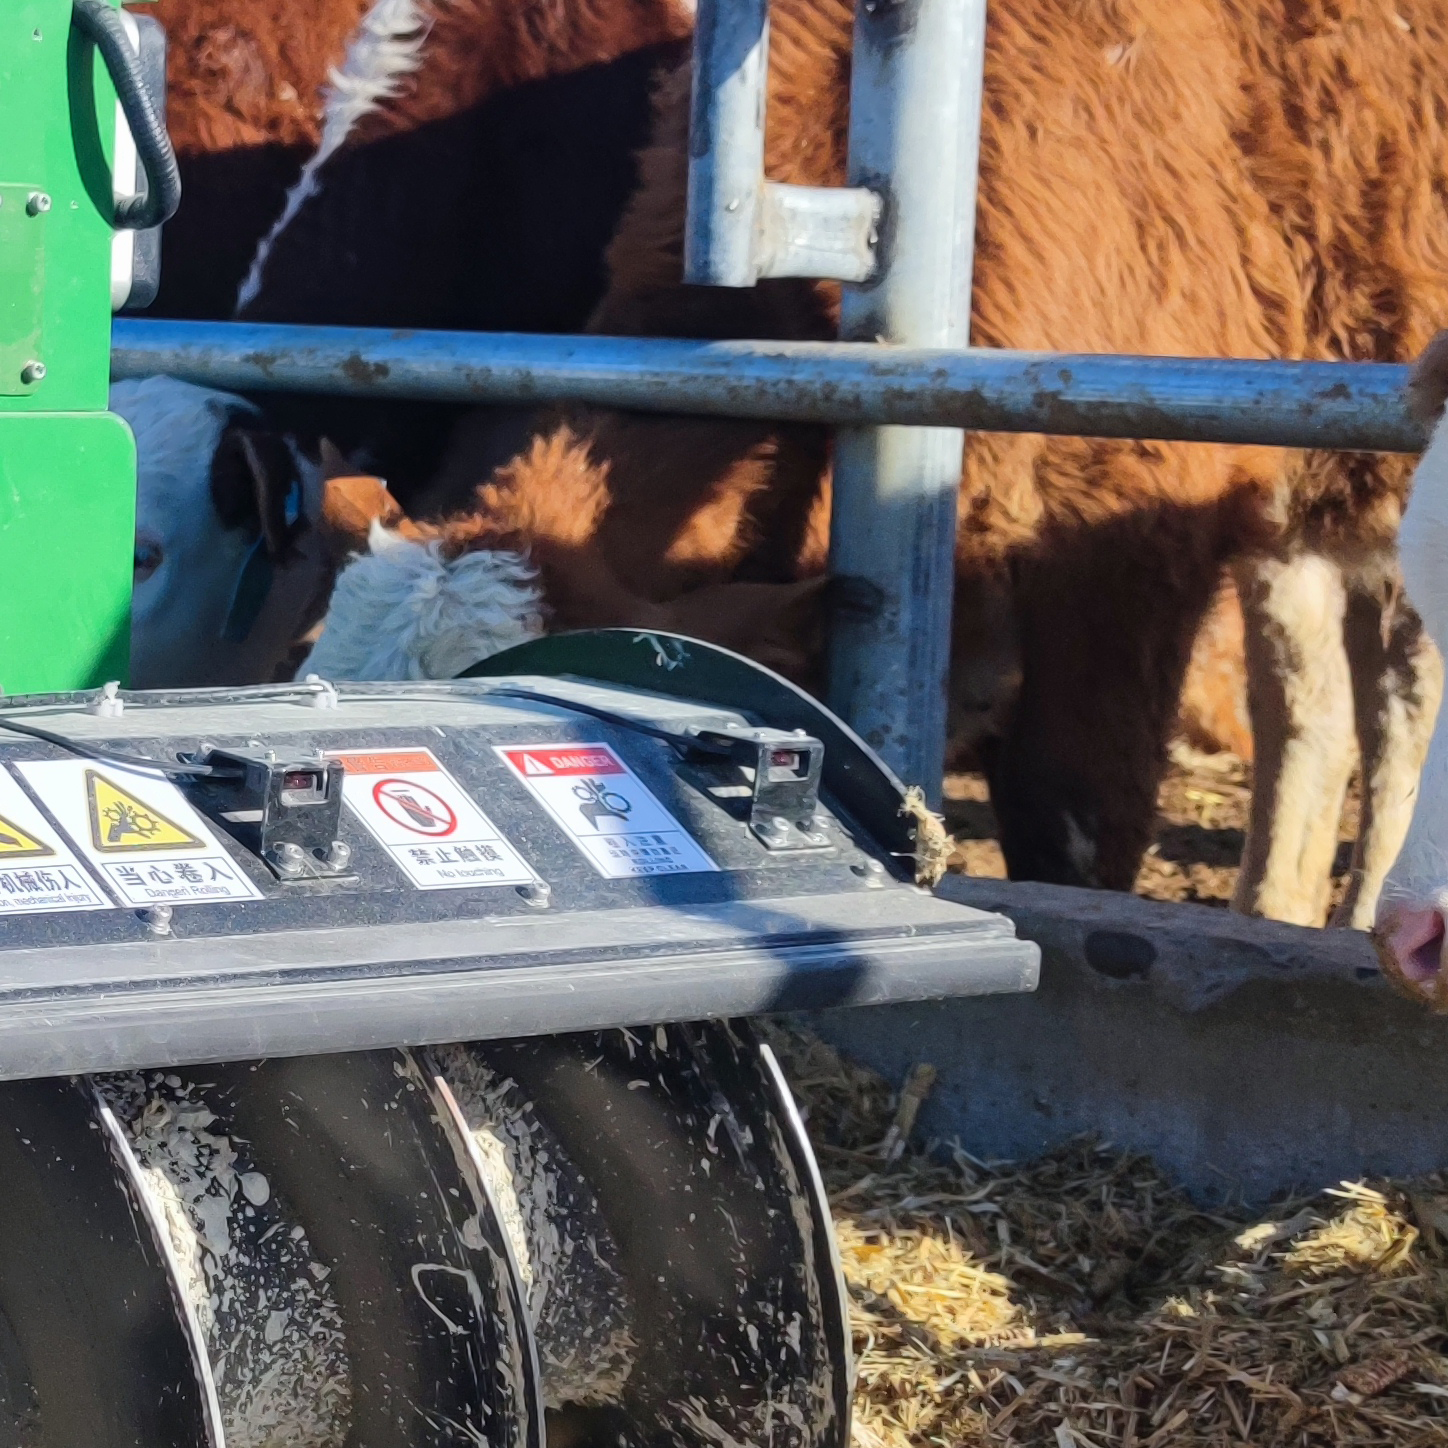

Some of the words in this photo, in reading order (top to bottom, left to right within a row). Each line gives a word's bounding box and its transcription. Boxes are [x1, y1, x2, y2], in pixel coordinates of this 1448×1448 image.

[549, 755, 615, 769] DANGER
[407, 844, 504, 866] 禁止触摸
[115, 861, 233, 887] 当心卷入
[436, 868, 455, 878] No
